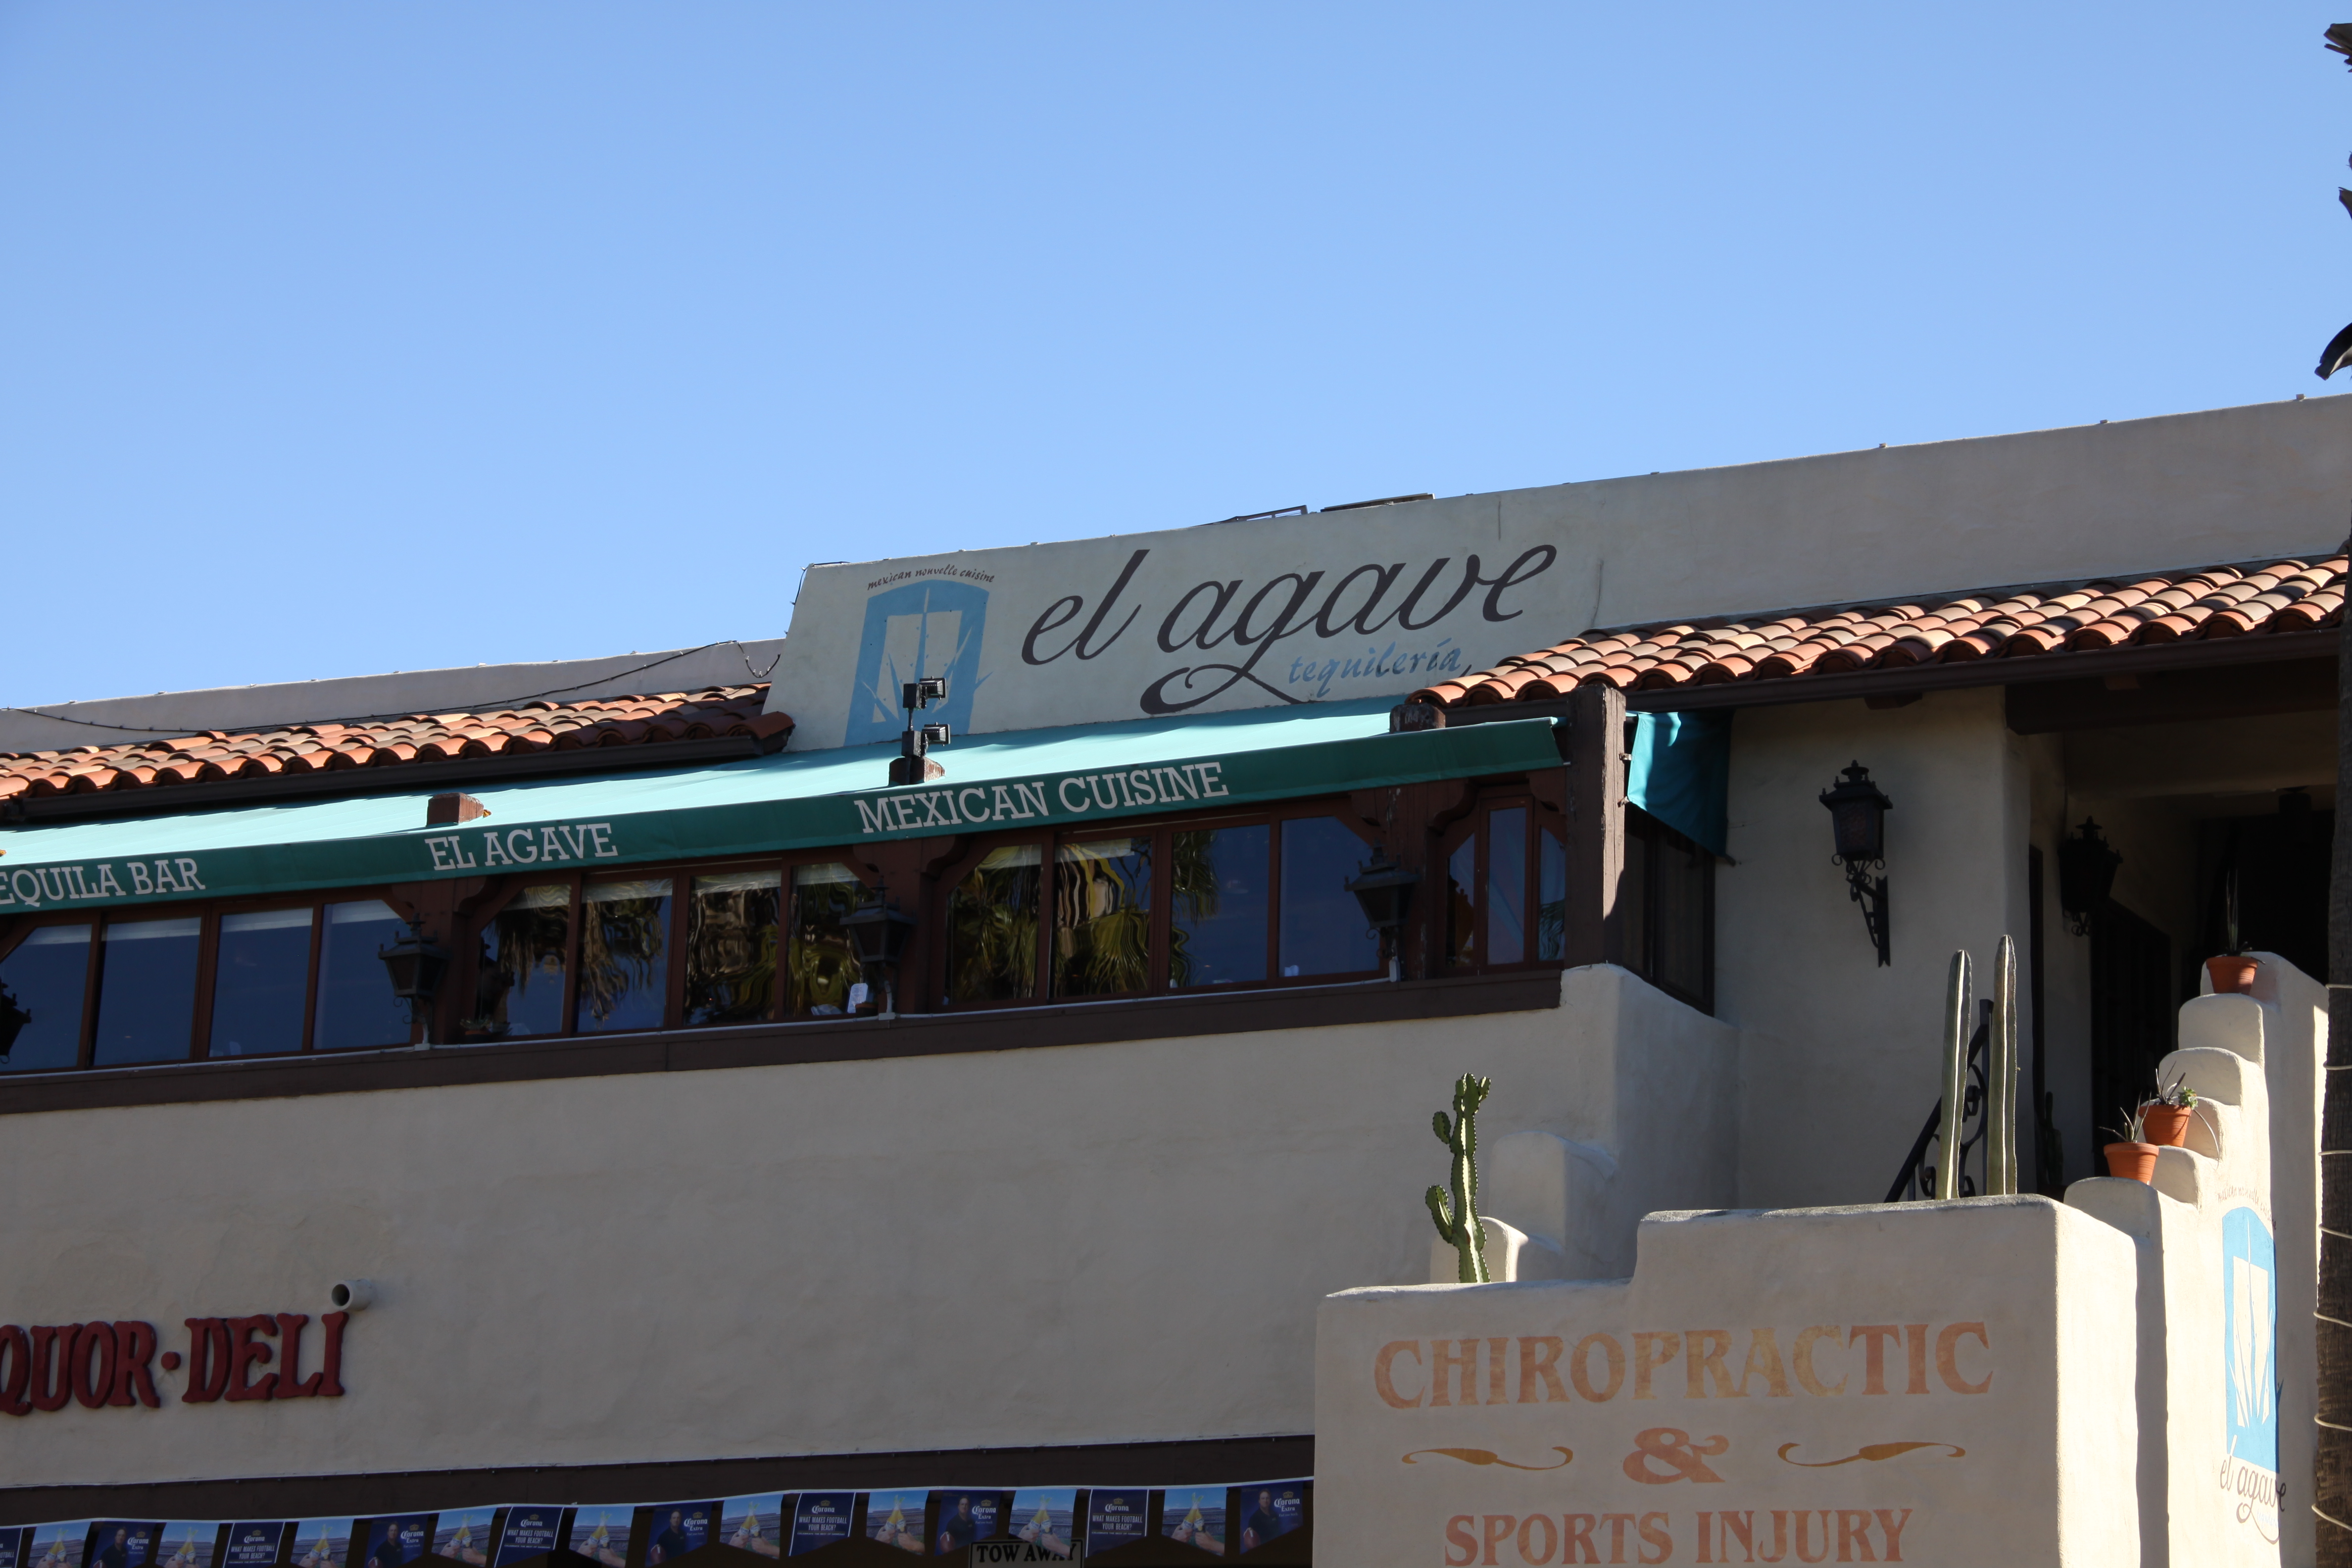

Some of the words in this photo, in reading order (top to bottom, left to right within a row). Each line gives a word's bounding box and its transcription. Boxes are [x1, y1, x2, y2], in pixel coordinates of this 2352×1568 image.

[867, 572, 912, 590] mexican
[915, 564, 958, 577] nouvelle
[960, 569, 995, 583] cuisine
[1022, 549, 1150, 665] el
[1140, 544, 1557, 715] agave
[1289, 637, 1462, 698] tequilería
[853, 781, 1050, 834] MEXICAN
[1058, 762, 1229, 813] CUISINE
[424, 835, 477, 870] EL
[483, 823, 618, 866] AGAVE
[127, 858, 206, 895] BAR
[182, 1311, 349, 1404] DELI
[1373, 1322, 1994, 1409] CHIROPRACTIC
[1622, 1426, 1729, 1484] &
[812, 1505, 835, 1515] Corona
[972, 1505, 996, 1516] Corona
[1105, 1503, 1129, 1513] Corona
[1274, 1498, 1300, 1508] Corona
[2236, 1466, 2286, 1545] agave
[400, 1530, 424, 1540] Corona
[520, 1519, 542, 1527] Corona
[683, 1518, 708, 1527] Corona
[127, 1537, 149, 1546] Corona
[244, 1535, 265, 1544] Corona
[1444, 1511, 1674, 1568] SPORTS
[1695, 1508, 1913, 1565] INJURY
[977, 1545, 1020, 1563] TOW
